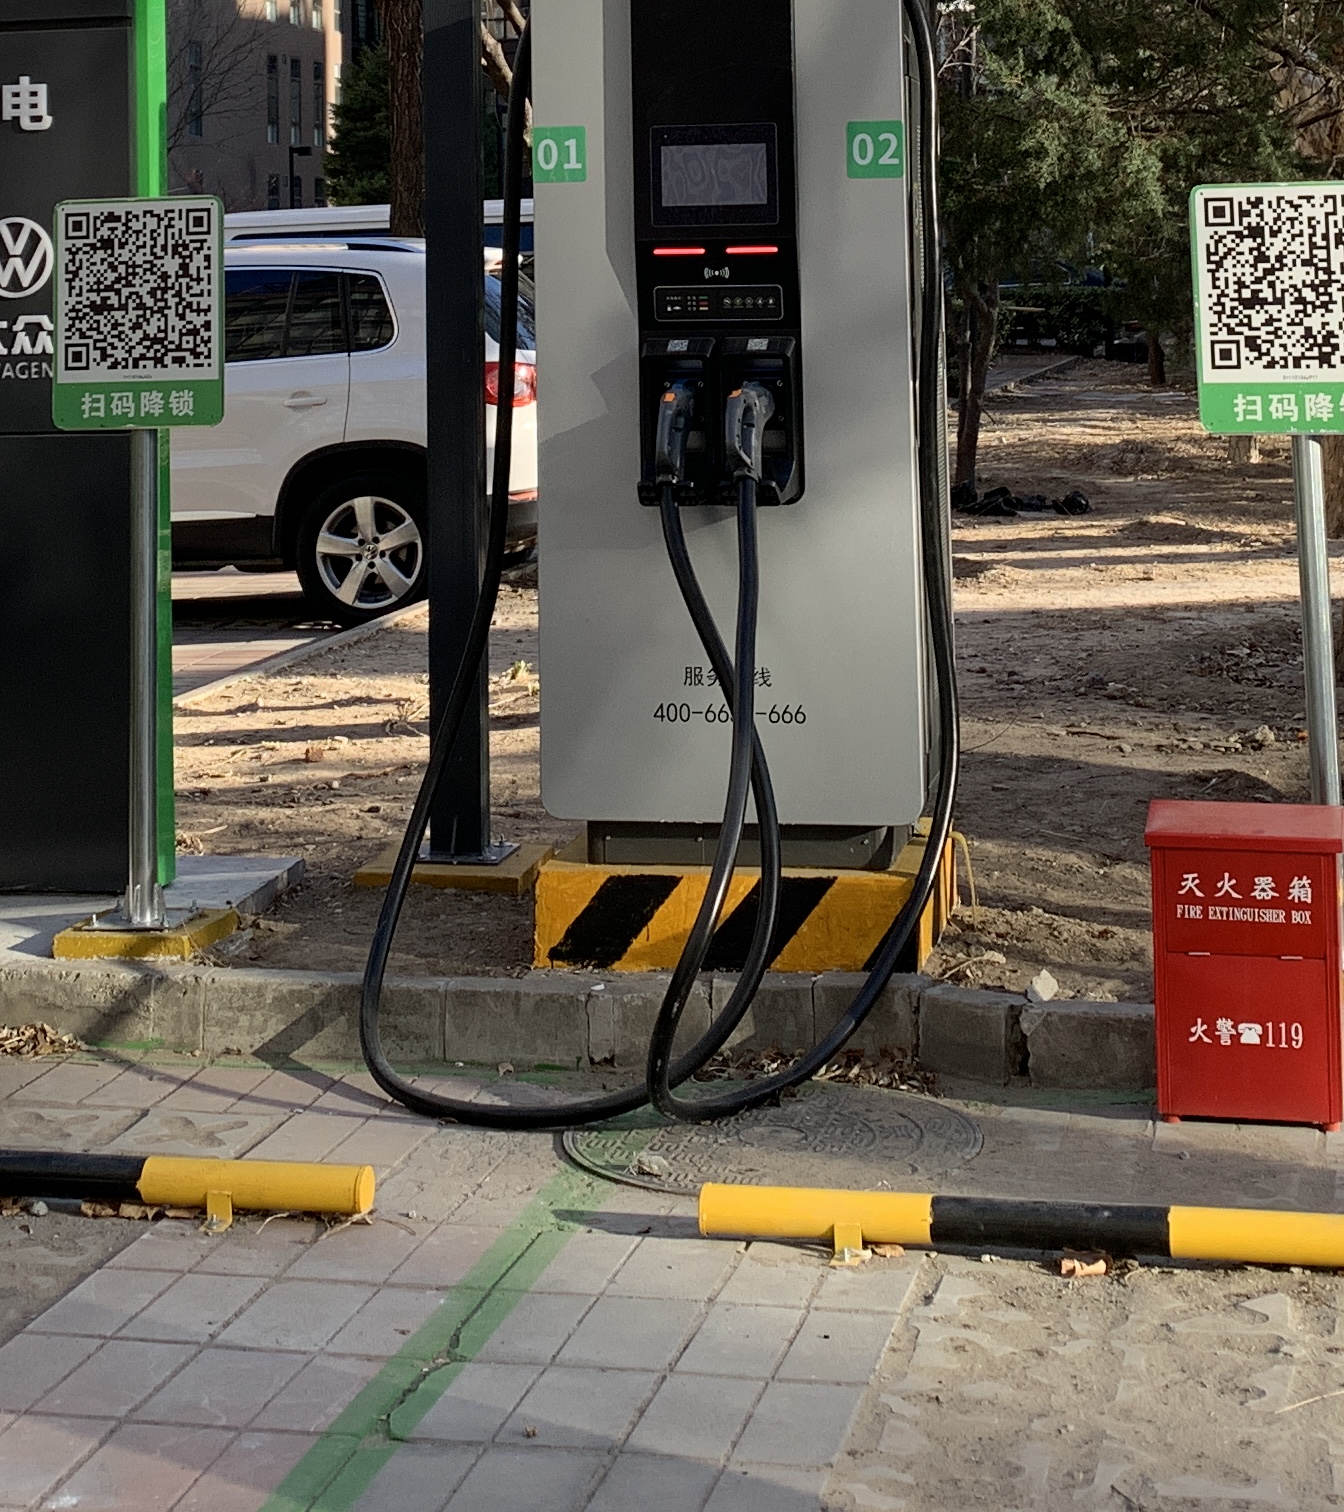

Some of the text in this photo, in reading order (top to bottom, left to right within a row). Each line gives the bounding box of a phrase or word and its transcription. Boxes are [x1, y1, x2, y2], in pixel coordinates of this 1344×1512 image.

[537, 138, 583, 170] 01
[852, 134, 900, 166] 02
[81, 390, 195, 419] 扫码降锁
[653, 702, 807, 724] 400-66-666
[1177, 872, 1313, 904] 灭火器箱
[1176, 904, 1312, 925] FIRE EXTINGUISHER BOX
[1188, 1017, 1304, 1049] 火警 119
